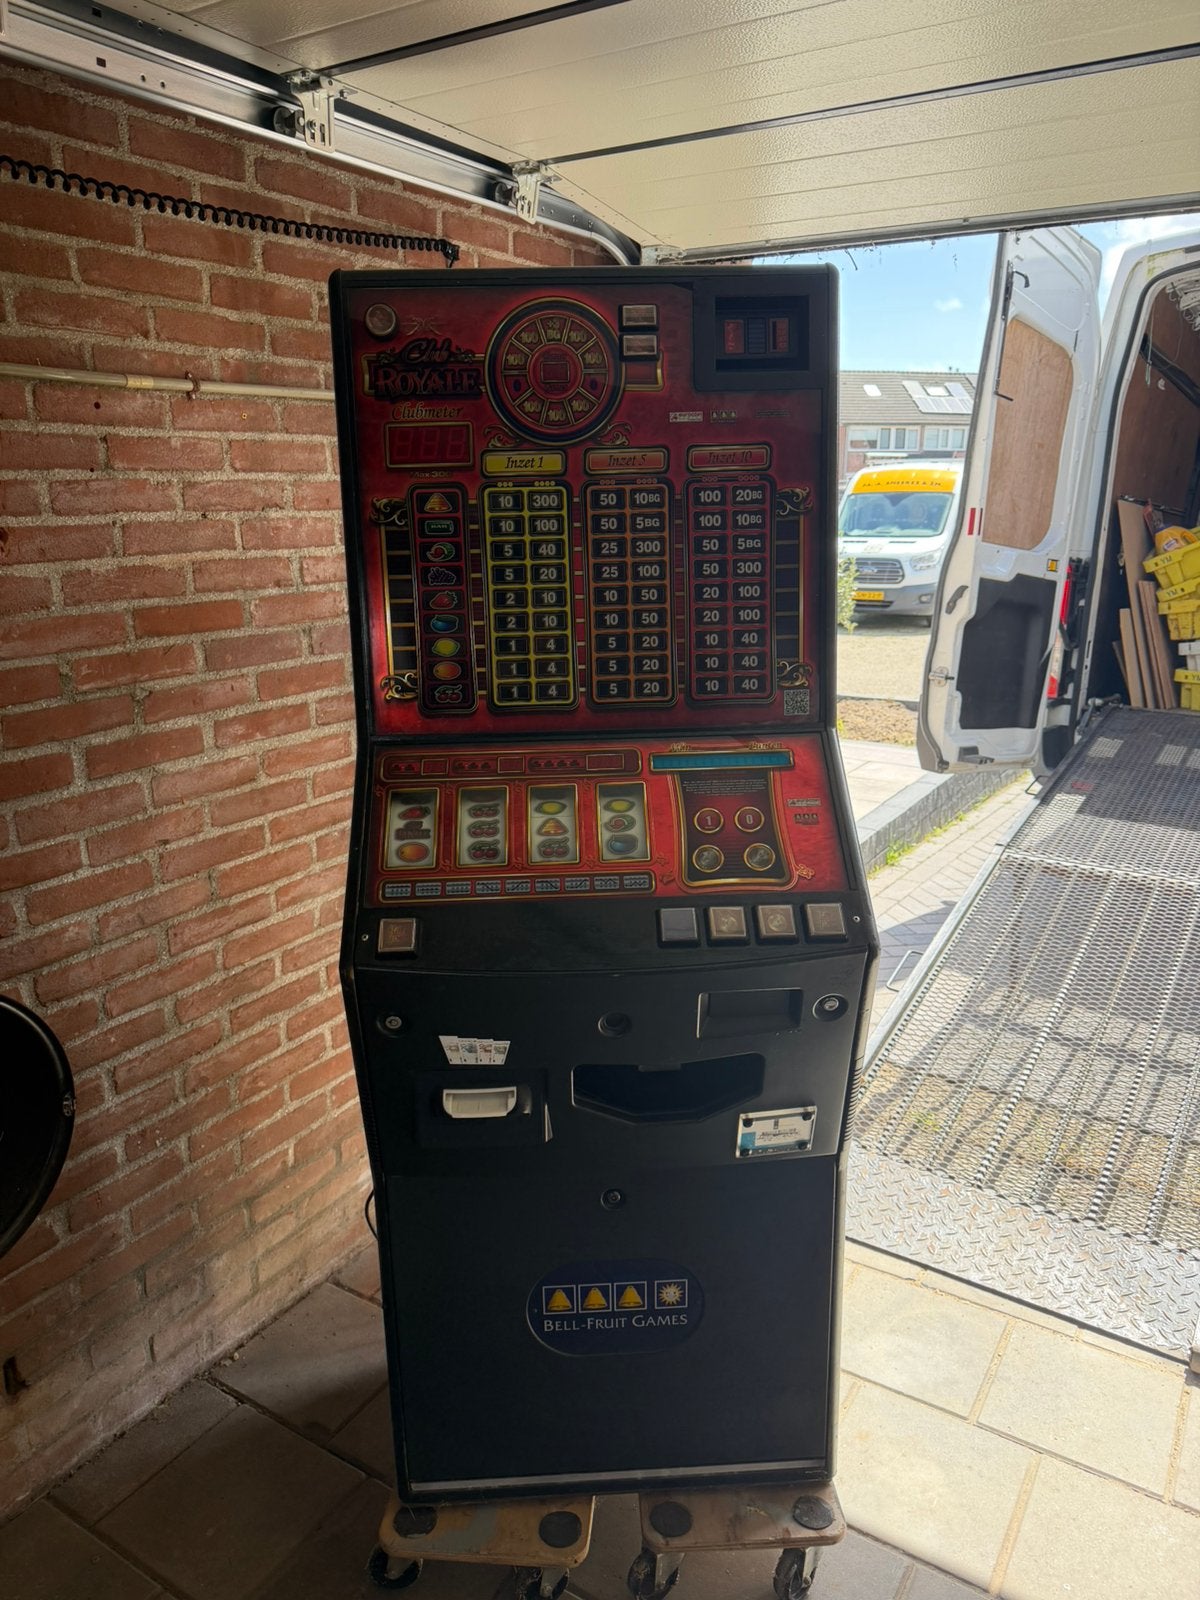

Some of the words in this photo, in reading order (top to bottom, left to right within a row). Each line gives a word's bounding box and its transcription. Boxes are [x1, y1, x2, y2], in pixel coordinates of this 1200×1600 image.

[519, 330, 539, 343] 100
[568, 329, 588, 343] 100
[401, 338, 452, 364] Club
[506, 352, 526, 366] 100
[583, 352, 603, 365] 100
[375, 366, 482, 396] ROYALE
[391, 401, 465, 421] Clubmeter
[522, 401, 541, 414] 100
[570, 400, 590, 413] 100
[547, 409, 567, 422] 100
[504, 456, 536, 469] Inzet
[537, 456, 544, 468] 1
[607, 454, 639, 467] Inzet
[640, 453, 648, 466] 5
[707, 452, 739, 465] Inzet
[740, 451, 753, 464] 10
[498, 495, 514, 508] 10
[532, 494, 558, 507] 300
[599, 492, 617, 506] 50
[634, 492, 661, 505] 10BG
[698, 490, 722, 503] 100
[735, 489, 763, 502] 20BG
[499, 519, 515, 532] 10
[534, 519, 558, 532] 100
[600, 517, 618, 530] 50
[636, 516, 660, 529] 5BG
[699, 514, 722, 527] 100
[736, 513, 762, 526] 10BG
[504, 544, 513, 557] 5
[538, 543, 557, 556] 40
[601, 542, 618, 554] 25
[636, 540, 661, 553] 300
[702, 538, 719, 551] 50
[737, 537, 761, 550] 5BG
[504, 568, 515, 581] 5
[539, 567, 557, 580] 20
[602, 566, 619, 578] 25
[637, 564, 660, 577] 100
[702, 562, 720, 575] 50
[736, 561, 762, 574] 300
[506, 592, 516, 605] 2
[541, 591, 557, 604] 10
[603, 589, 618, 602] 10
[641, 588, 658, 601] 50
[702, 586, 720, 599] 20
[738, 585, 761, 598] 100
[507, 616, 516, 629] 2
[542, 615, 558, 628] 10
[604, 613, 619, 626] 10
[641, 612, 659, 625] 50
[703, 610, 720, 622] 20
[738, 608, 761, 621] 100
[509, 639, 516, 652] 1
[546, 638, 556, 651] 4
[608, 636, 617, 649] 5
[642, 635, 659, 648] 20
[704, 633, 719, 646] 10
[741, 632, 758, 644] 40
[510, 663, 517, 676] 1
[547, 661, 557, 674] 4
[609, 659, 617, 672] 5
[642, 659, 660, 671] 20
[704, 656, 719, 669] 10
[741, 655, 758, 667] 40
[511, 685, 518, 698] 1
[548, 684, 558, 697] 4
[609, 682, 618, 695] 5
[643, 681, 660, 694] 20
[705, 679, 720, 692] 10
[741, 678, 758, 690] 40
[705, 815, 712, 825] 1
[746, 814, 753, 824] 0
[543, 1316, 628, 1332] BELL-FRUIT
[631, 1313, 688, 1328] GAMES
